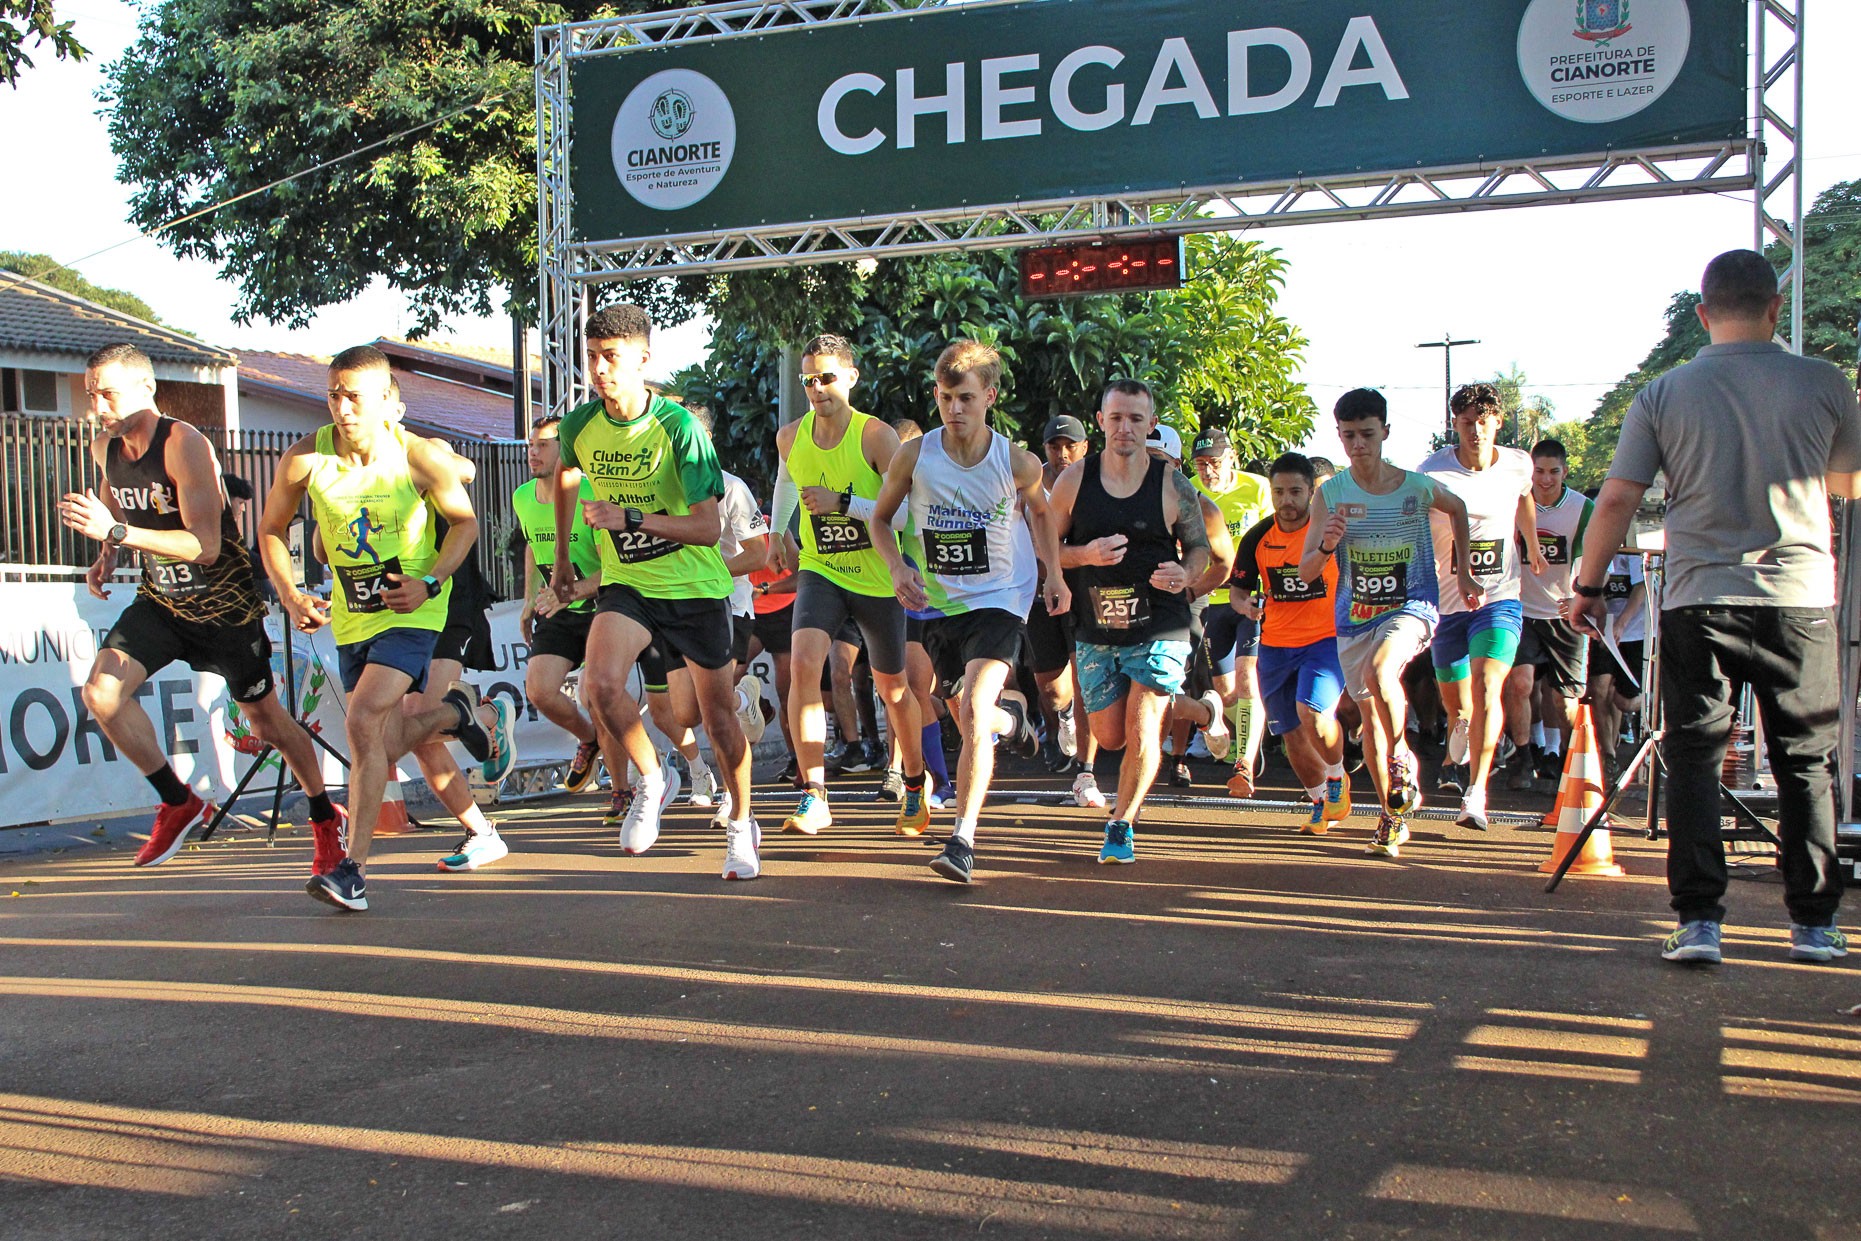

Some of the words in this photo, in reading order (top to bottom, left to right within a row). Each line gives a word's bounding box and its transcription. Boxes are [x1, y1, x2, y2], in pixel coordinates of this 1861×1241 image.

[1550, 48, 1633, 66] PREFEITURA
[1637, 45, 1656, 57] DE
[1550, 58, 1655, 82] CIANORTE
[818, 15, 1409, 155] CHEGADA
[1551, 90, 1603, 104] ESPORTE
[1607, 89, 1614, 98] E
[1617, 85, 1654, 97] LAZER
[627, 140, 721, 168] CIANORTE
[626, 170, 661, 182] Esporte
[663, 169, 676, 177] de
[677, 164, 721, 176] Aventura
[648, 182, 654, 190] e
[656, 178, 698, 189] Natureza
[593, 450, 633, 462] Clube
[589, 462, 629, 476] 12km
[927, 516, 986, 529] Runners
[820, 525, 859, 542] 320
[936, 543, 974, 563] 331
[1349, 547, 1410, 562] ATLETISMO
[156, 564, 193, 584] 213
[354, 577, 389, 601] 54
[1283, 577, 1309, 592] 83
[1356, 576, 1397, 594] 399
[1609, 581, 1627, 592] 86
[1101, 597, 1139, 617] 257
